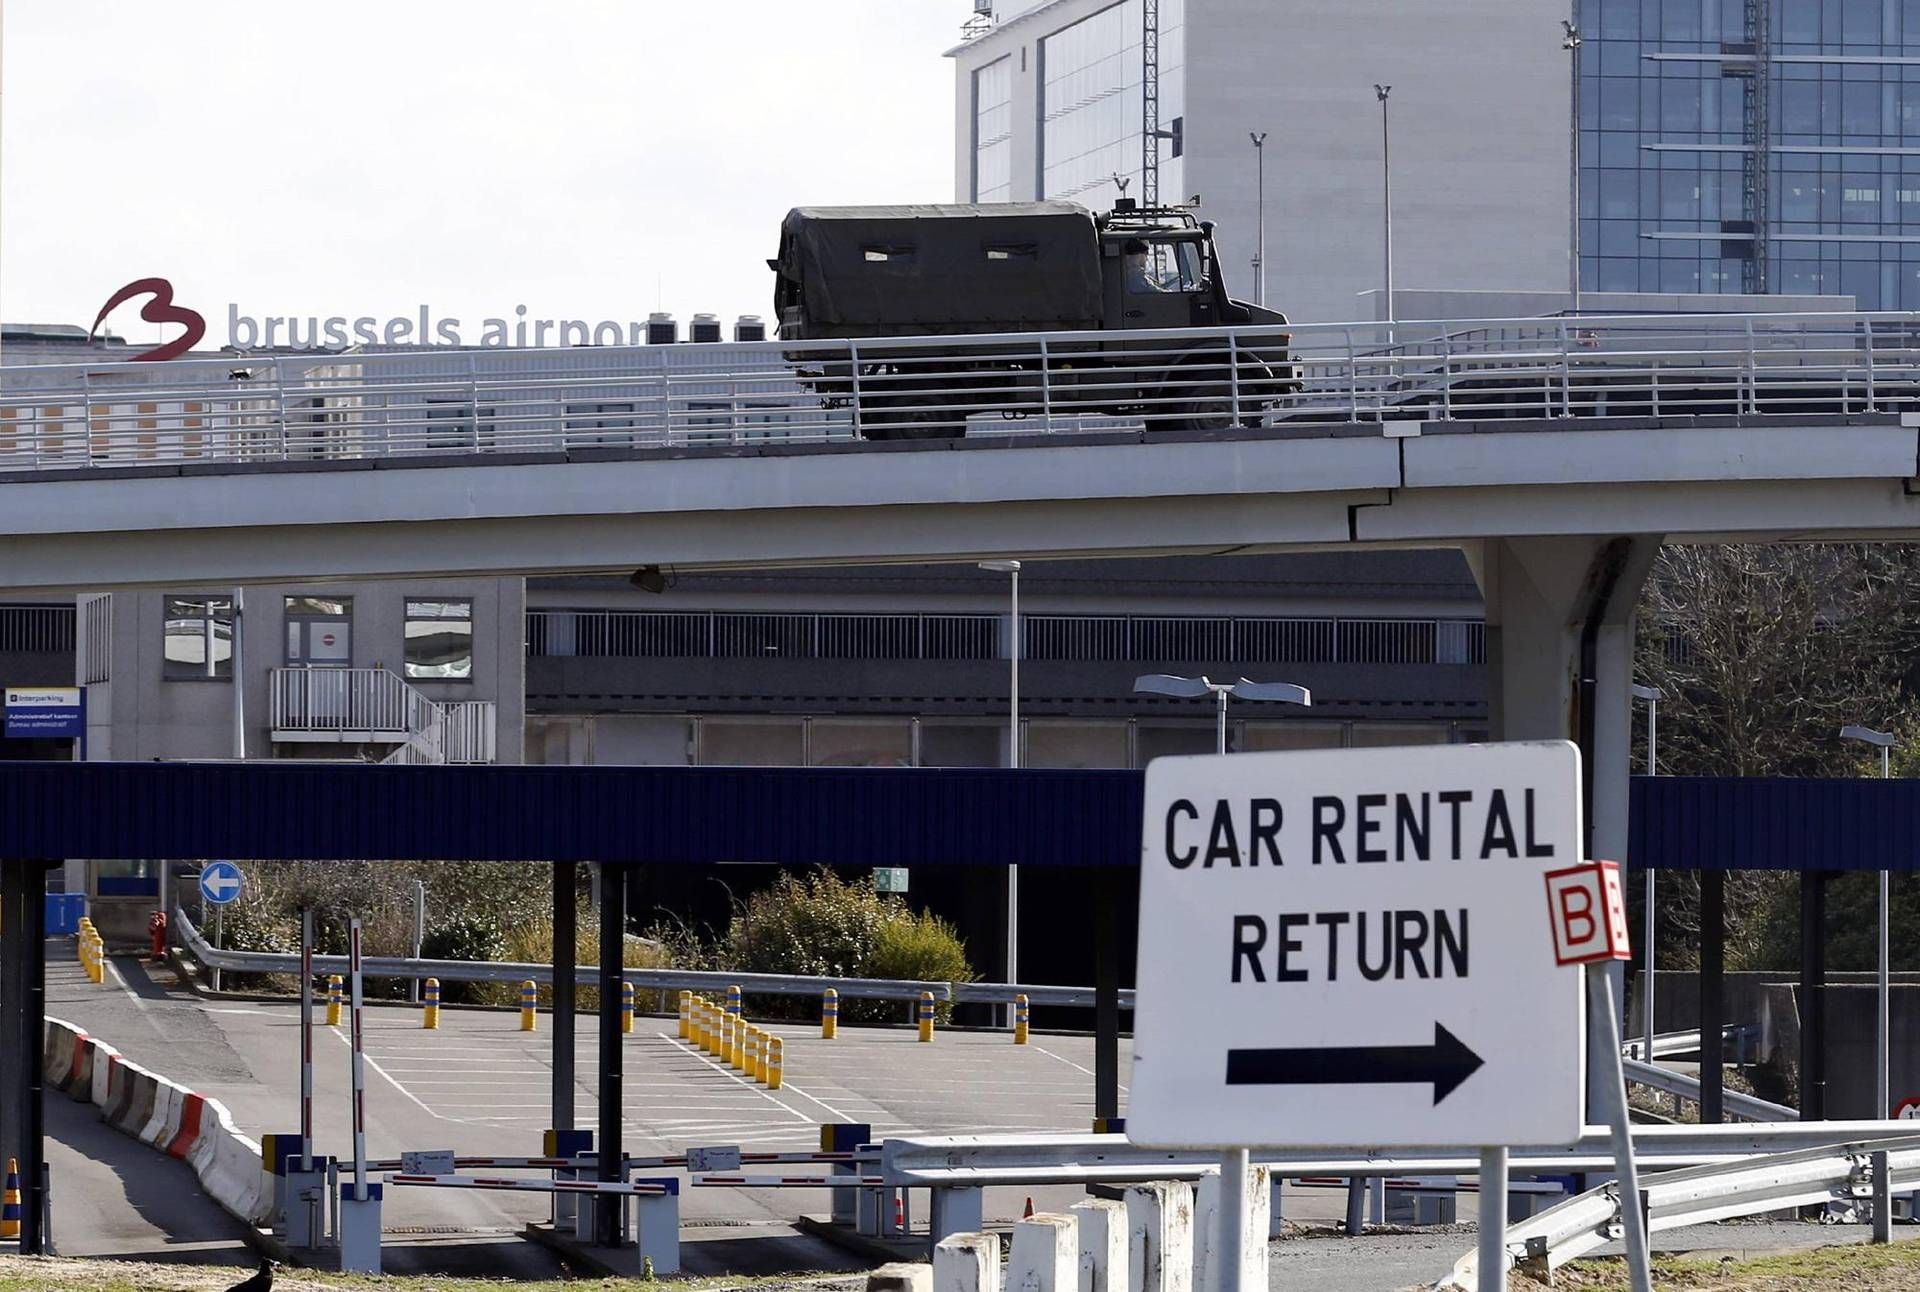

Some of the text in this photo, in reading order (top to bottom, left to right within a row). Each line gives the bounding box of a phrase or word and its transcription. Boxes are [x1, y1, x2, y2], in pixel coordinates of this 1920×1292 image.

[228, 303, 650, 348] brussels airpor
[1164, 788, 1555, 869] CAR RENTAL
[1231, 908, 1469, 983] RETURN
[1559, 886, 1596, 946] B
